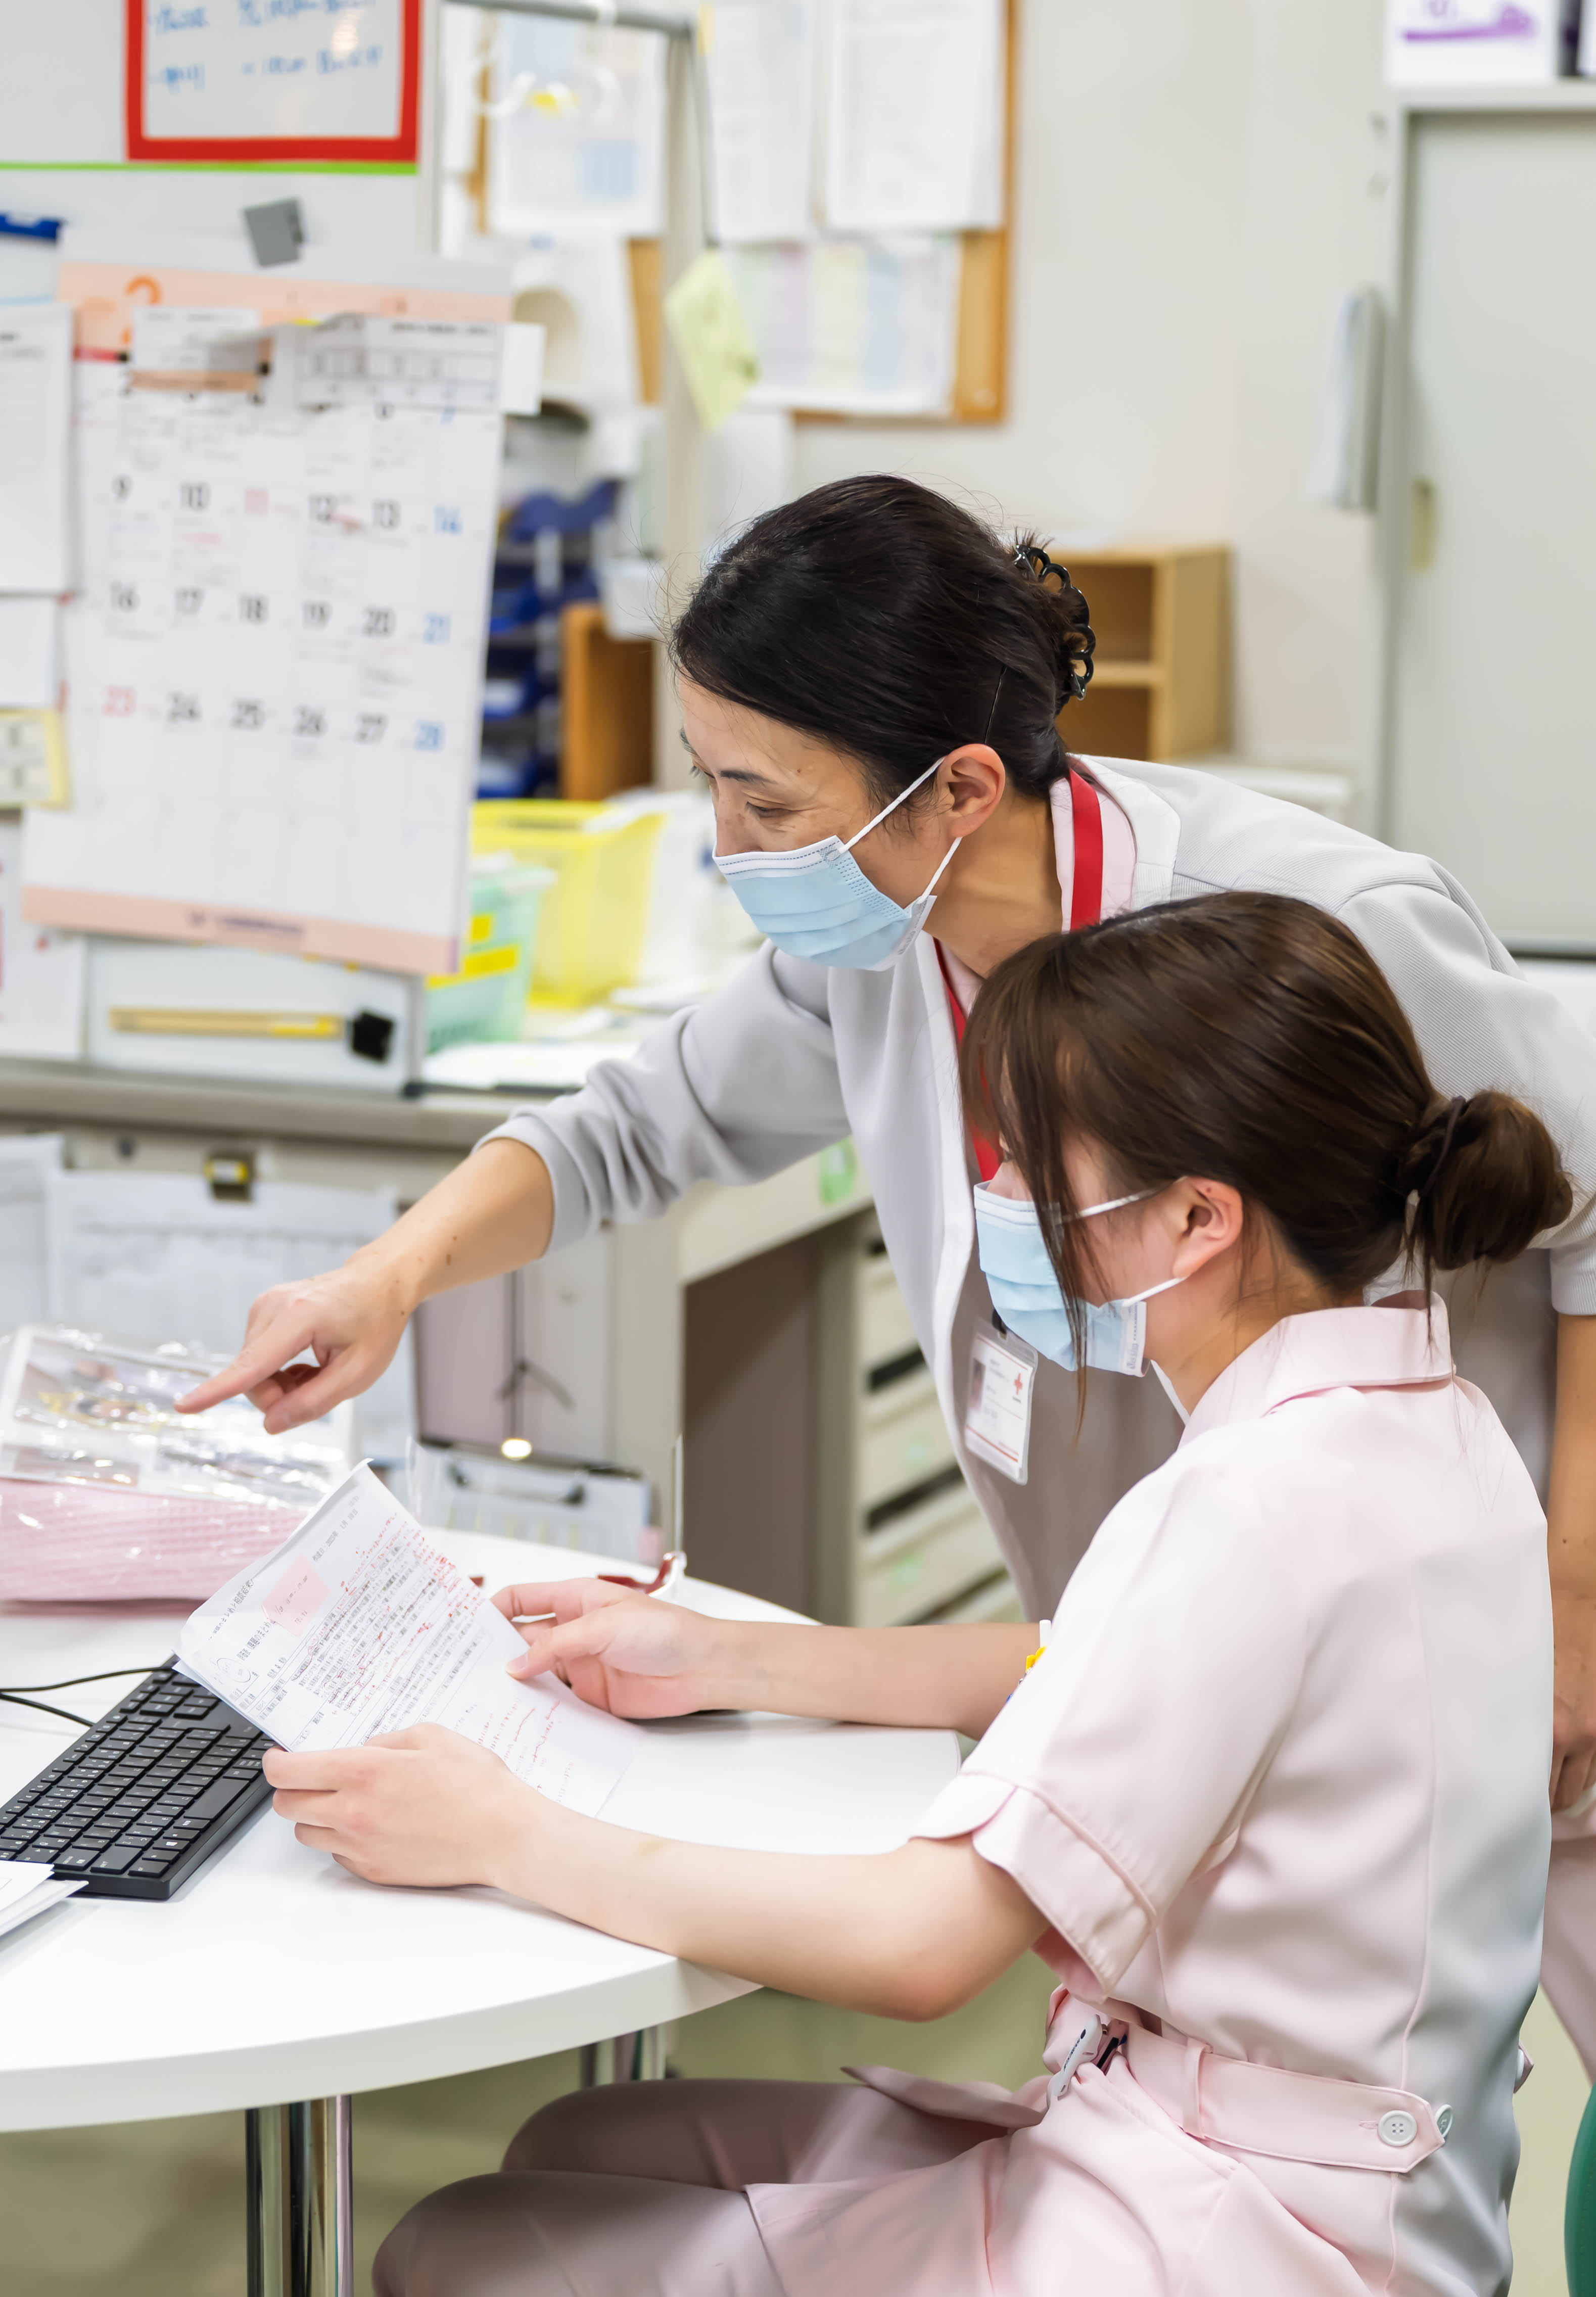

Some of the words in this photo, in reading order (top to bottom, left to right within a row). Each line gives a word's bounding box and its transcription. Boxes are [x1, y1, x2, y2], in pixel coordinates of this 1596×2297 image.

[179, 481, 211, 511] 10
[372, 500, 401, 530] 13
[110, 582, 139, 612] 16
[175, 587, 203, 615] 17
[239, 593, 268, 624] 18
[302, 600, 331, 629] 19
[362, 606, 396, 637] 20
[423, 613, 451, 645] 21
[104, 687, 135, 717] 23
[167, 692, 200, 721] 24
[231, 698, 265, 729] 25
[295, 707, 327, 736] 26
[356, 714, 388, 742] 27
[414, 721, 446, 752] 28
